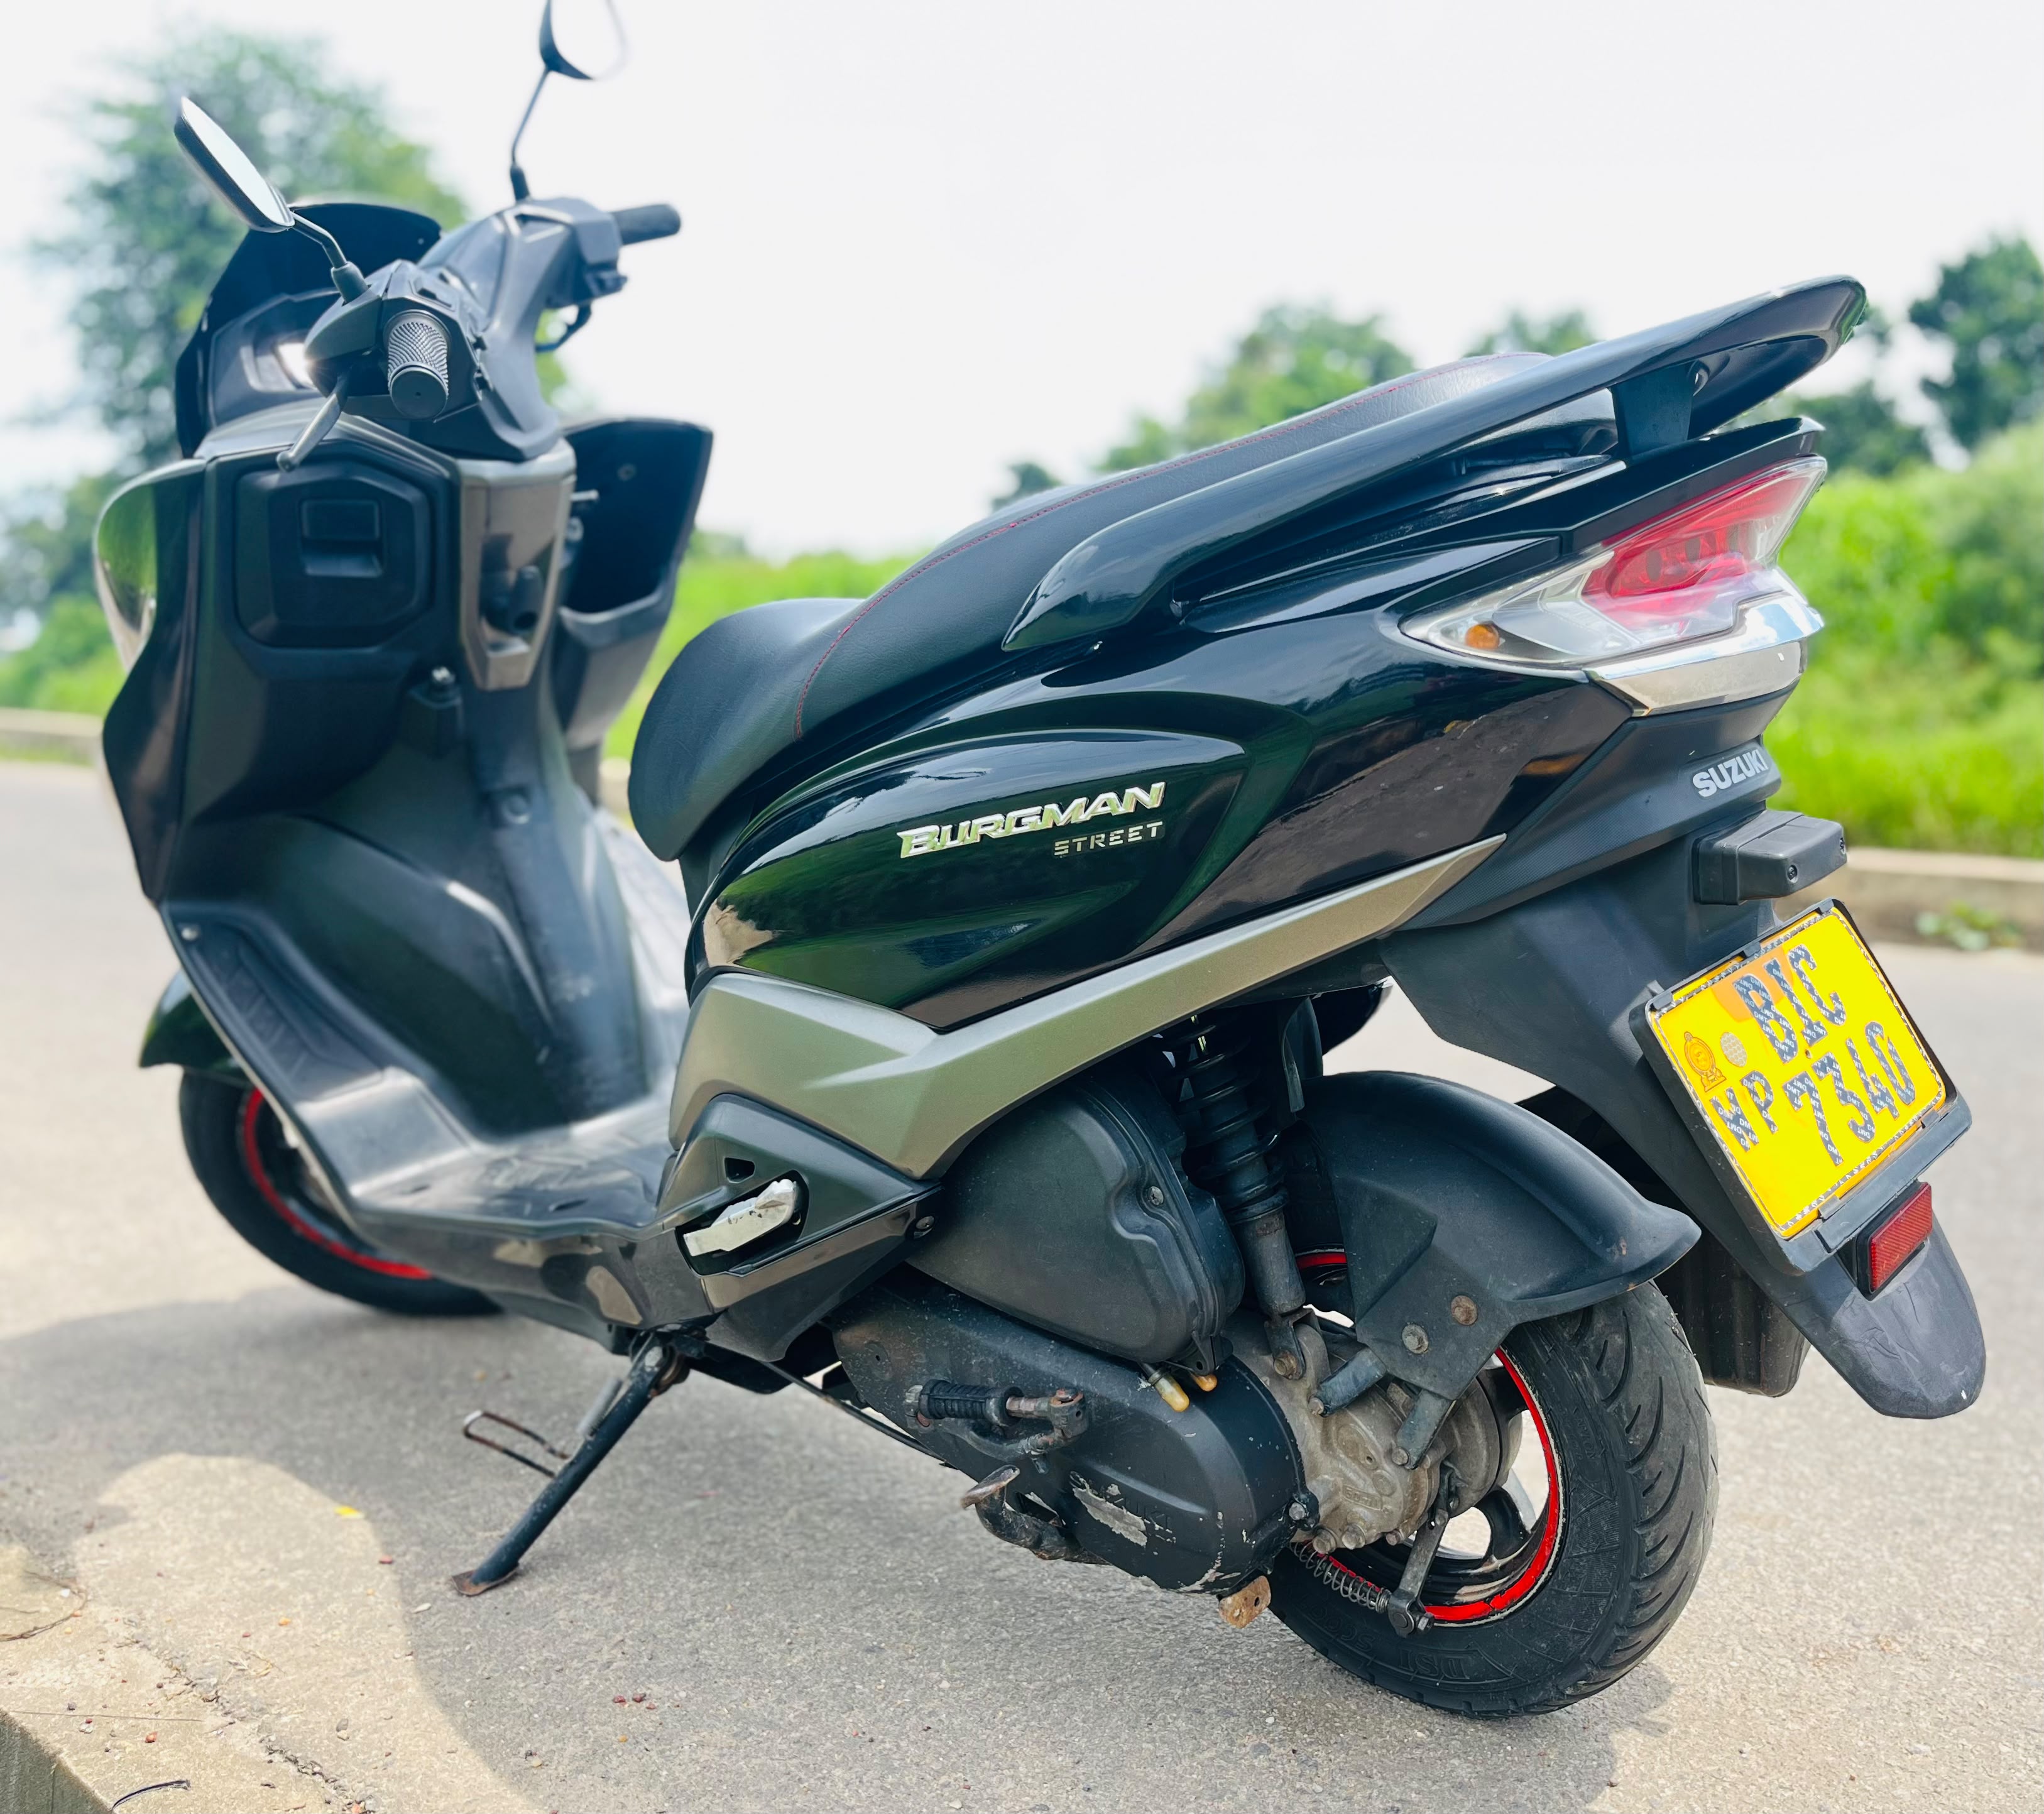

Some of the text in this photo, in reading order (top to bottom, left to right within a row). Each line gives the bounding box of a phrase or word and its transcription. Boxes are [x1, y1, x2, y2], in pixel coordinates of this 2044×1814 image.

[1692, 749, 1768, 797] SUZUKI
[896, 782, 1166, 859] BURGMAN
[1054, 821, 1163, 856] STREET
[1733, 943, 1847, 1064] BIC
[1709, 1021, 1916, 1167] WP 7340
